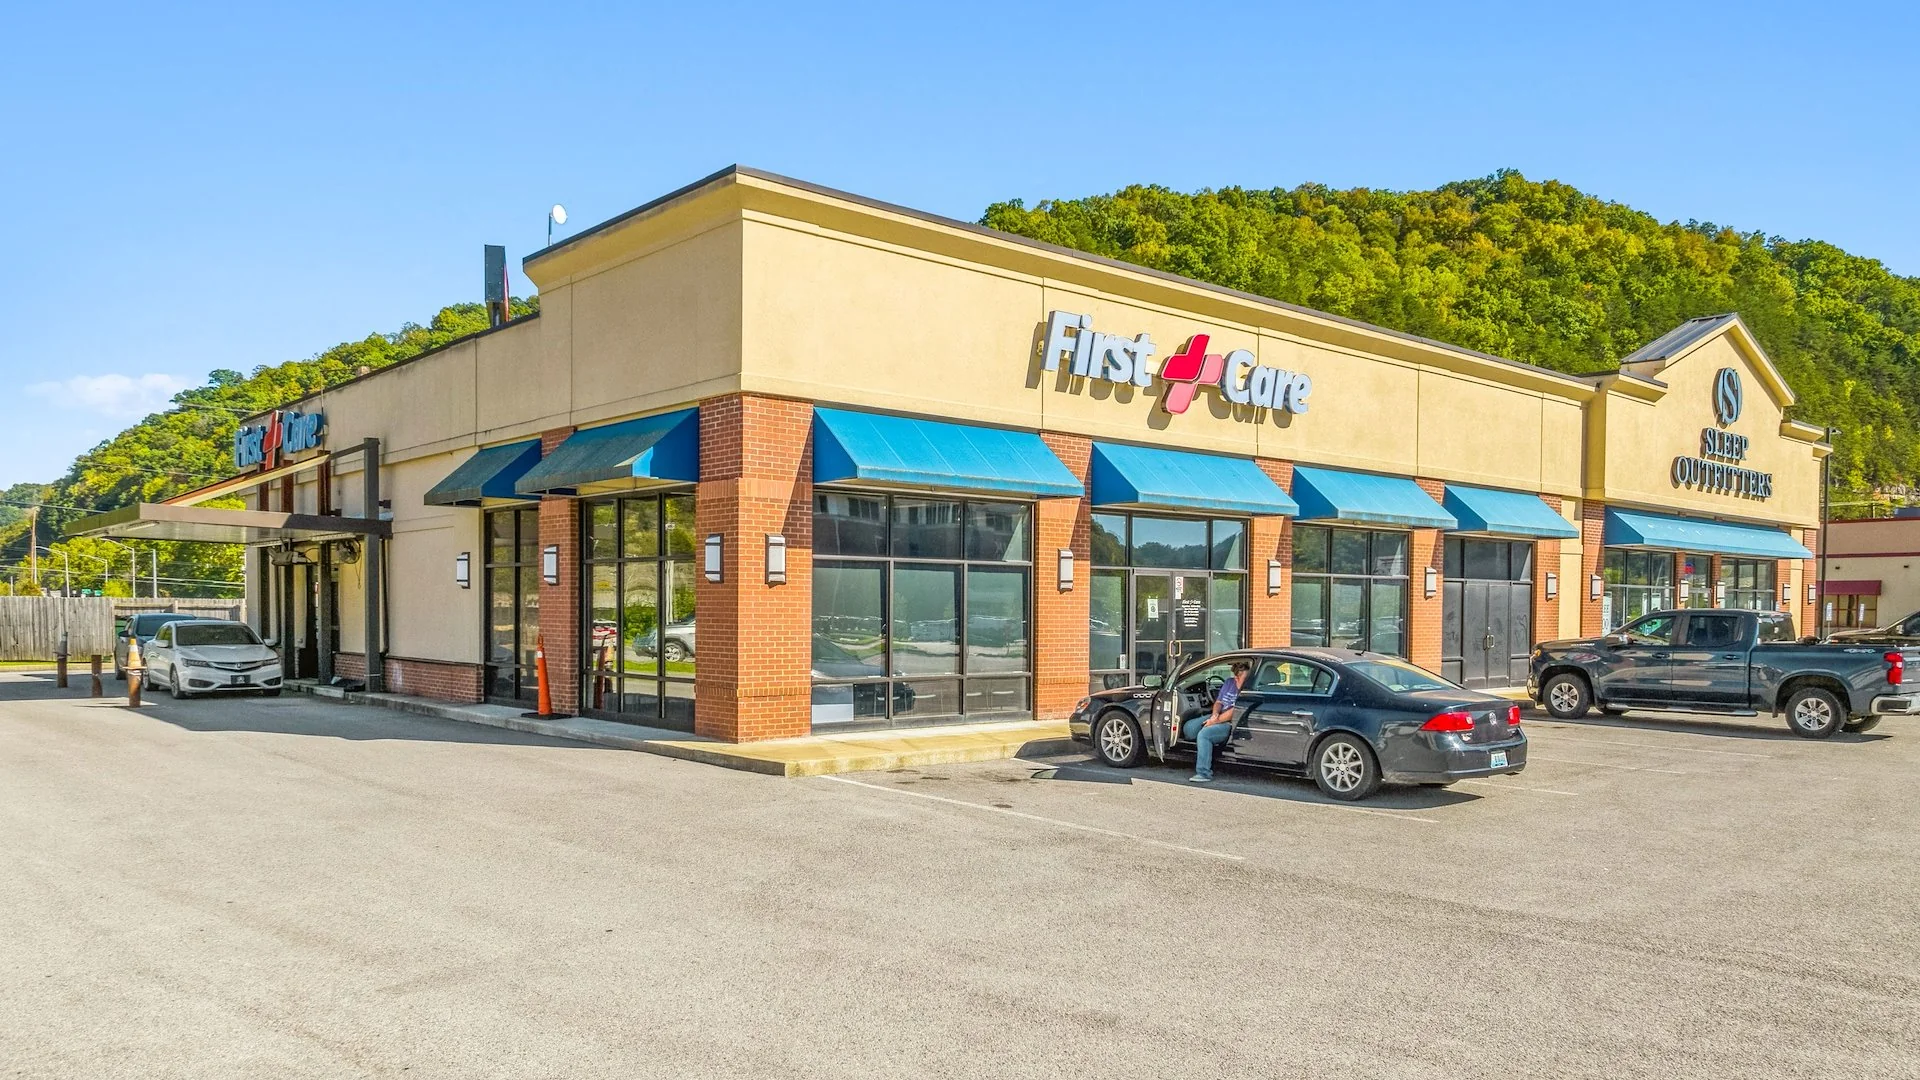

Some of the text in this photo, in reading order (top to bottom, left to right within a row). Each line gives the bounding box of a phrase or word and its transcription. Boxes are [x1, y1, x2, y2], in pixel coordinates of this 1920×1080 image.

[1041, 310, 1312, 414] First Care
[234, 411, 325, 467] First Care
[1705, 428, 1750, 461] SLEEP
[1675, 456, 1773, 498] OUTFITTERS
